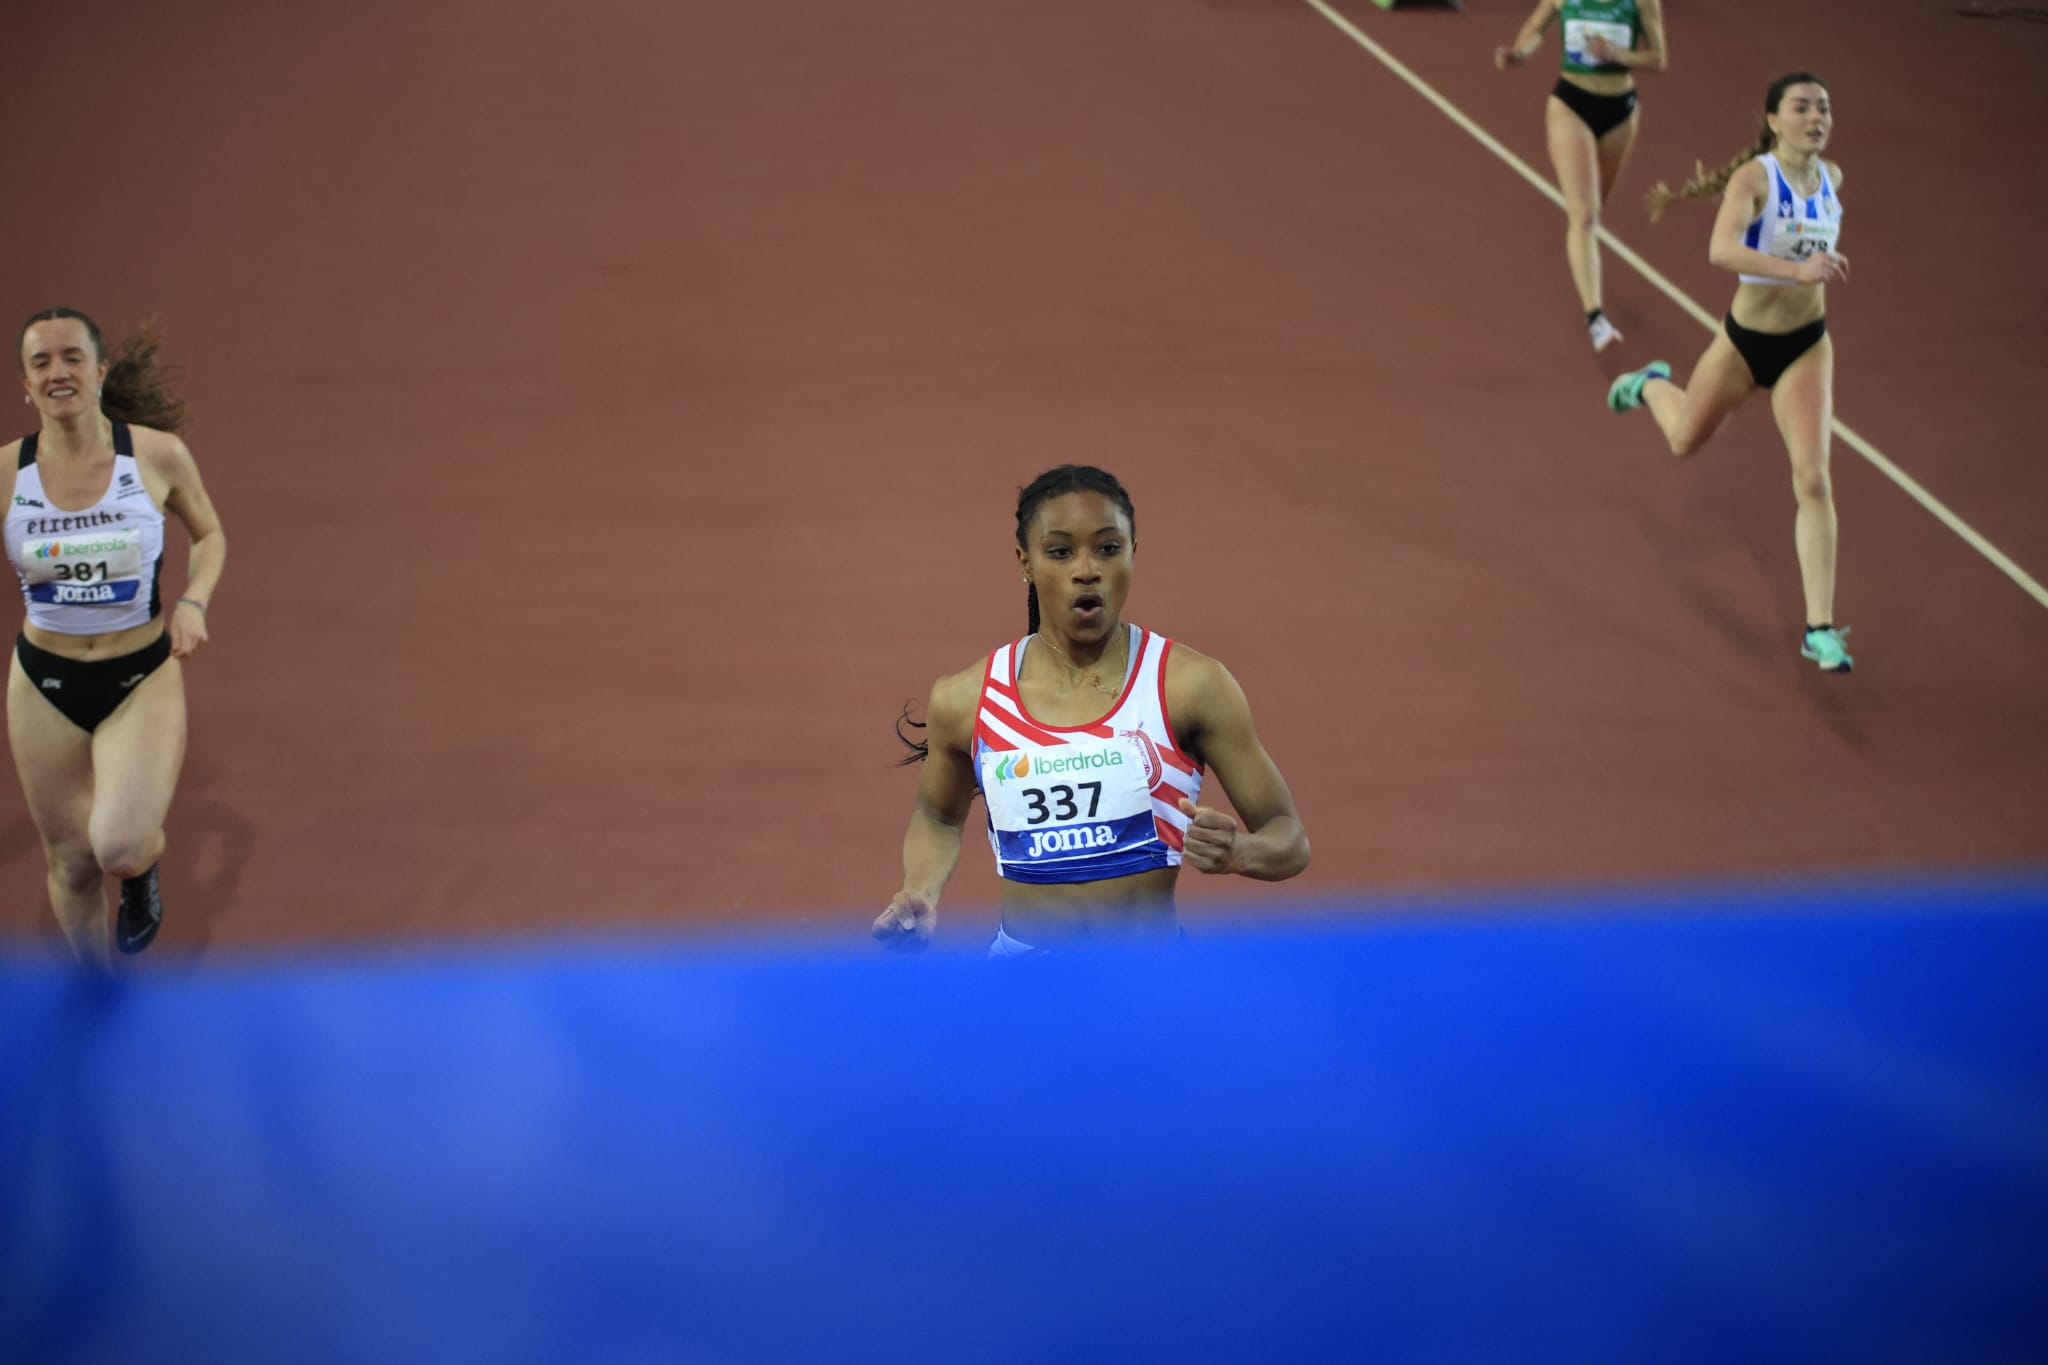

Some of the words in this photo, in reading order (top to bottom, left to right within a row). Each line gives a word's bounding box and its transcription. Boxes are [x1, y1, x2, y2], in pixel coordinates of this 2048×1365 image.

[63, 538, 128, 556] Iberdrola
[53, 560, 108, 582] 381
[53, 584, 116, 604] Joma
[1034, 747, 1124, 776] Iberdrola
[1021, 780, 1103, 826] 337
[1028, 824, 1118, 858] Joma
